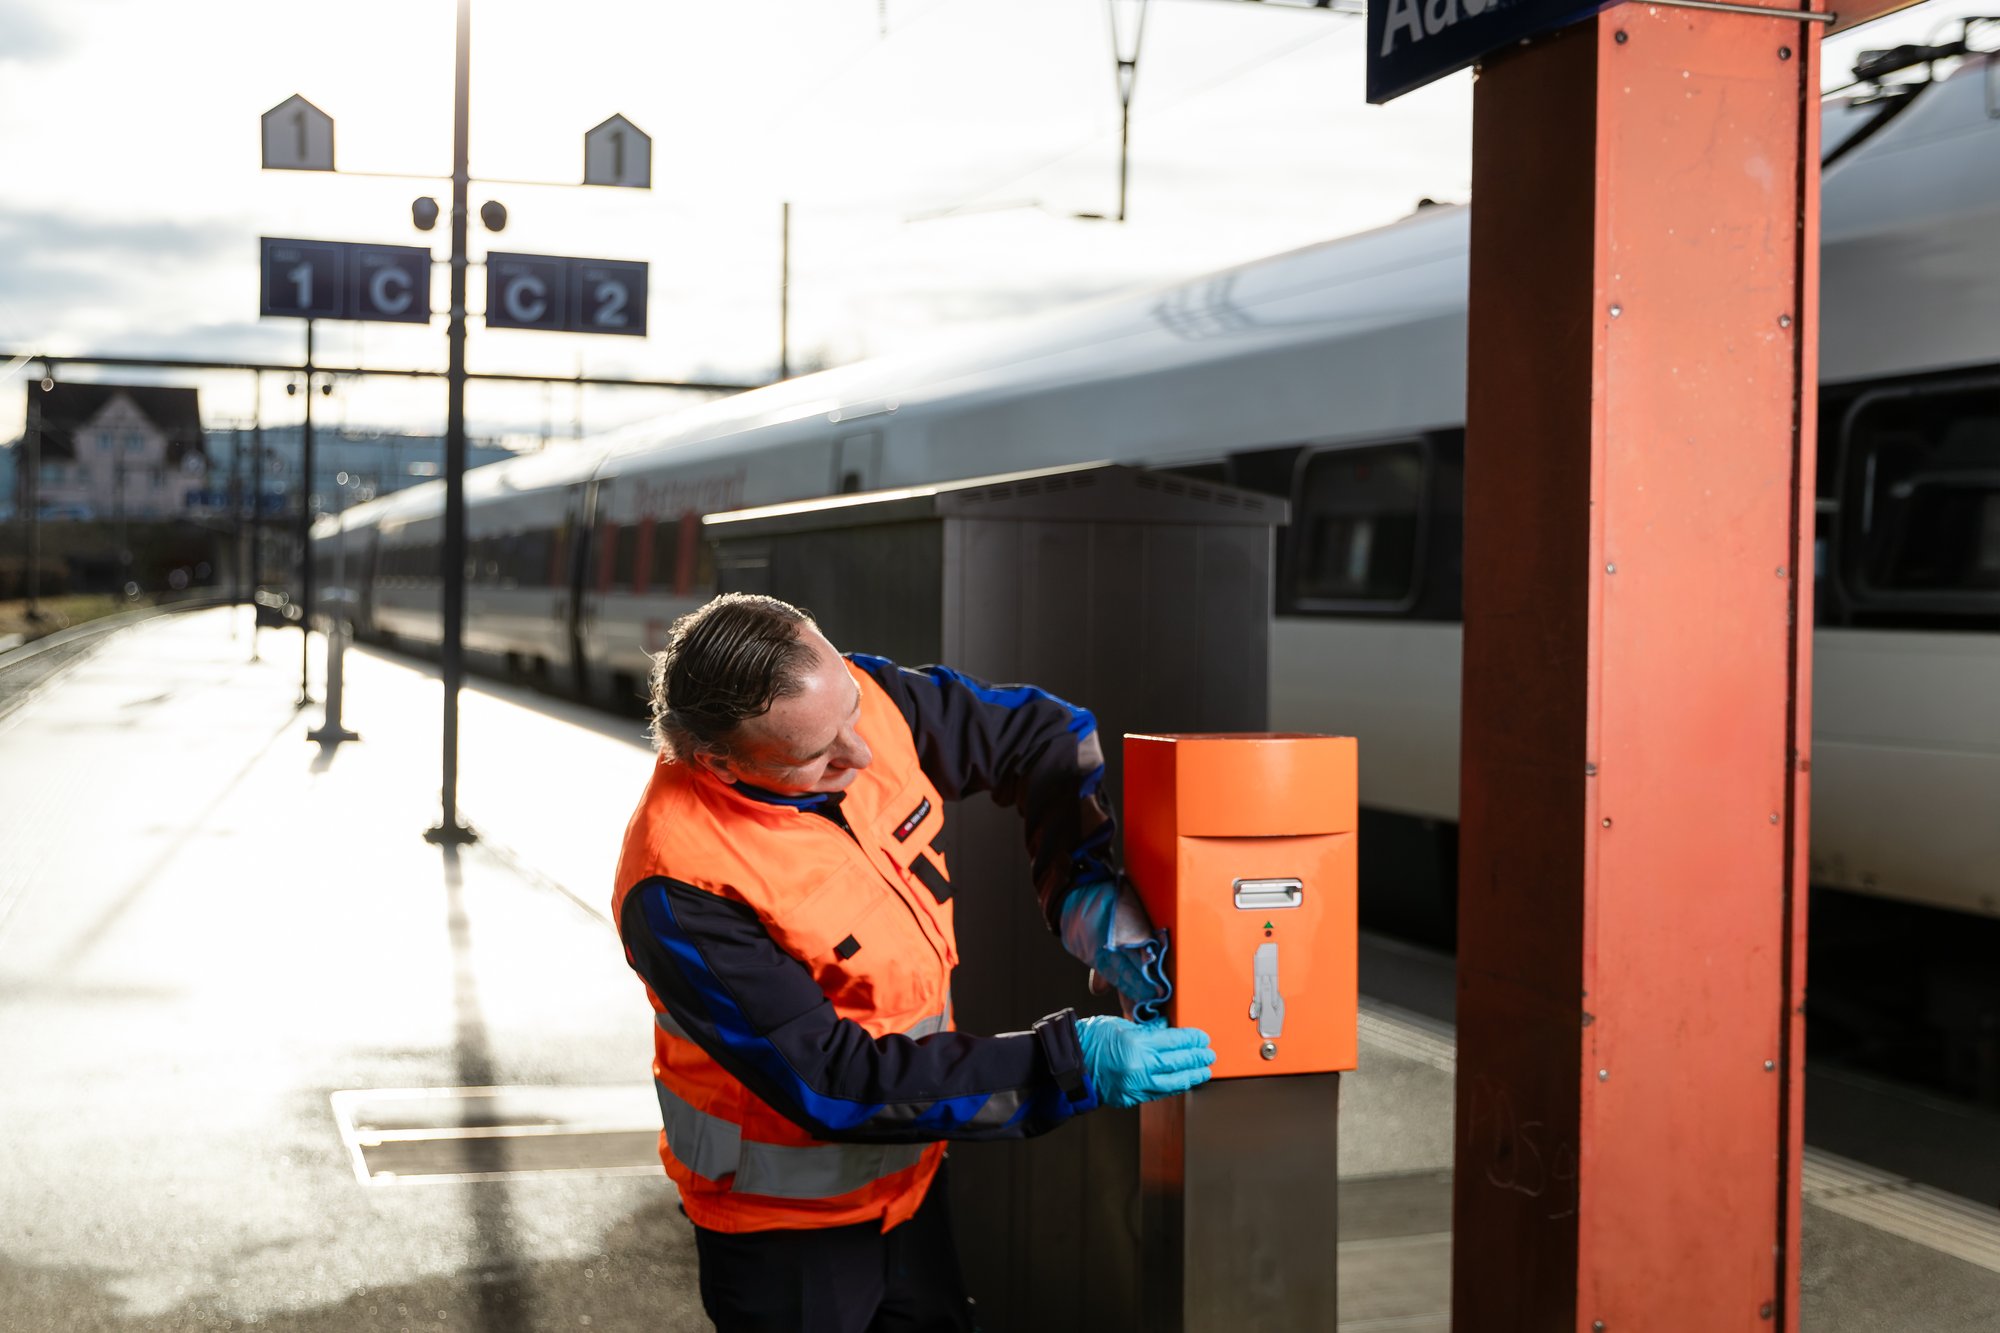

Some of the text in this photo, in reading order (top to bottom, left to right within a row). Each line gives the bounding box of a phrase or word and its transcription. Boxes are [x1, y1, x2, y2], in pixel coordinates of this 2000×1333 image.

[290, 107, 307, 162] 1
[608, 131, 624, 178] 1
[288, 262, 412, 315] 1 C
[505, 275, 628, 326] C 2
